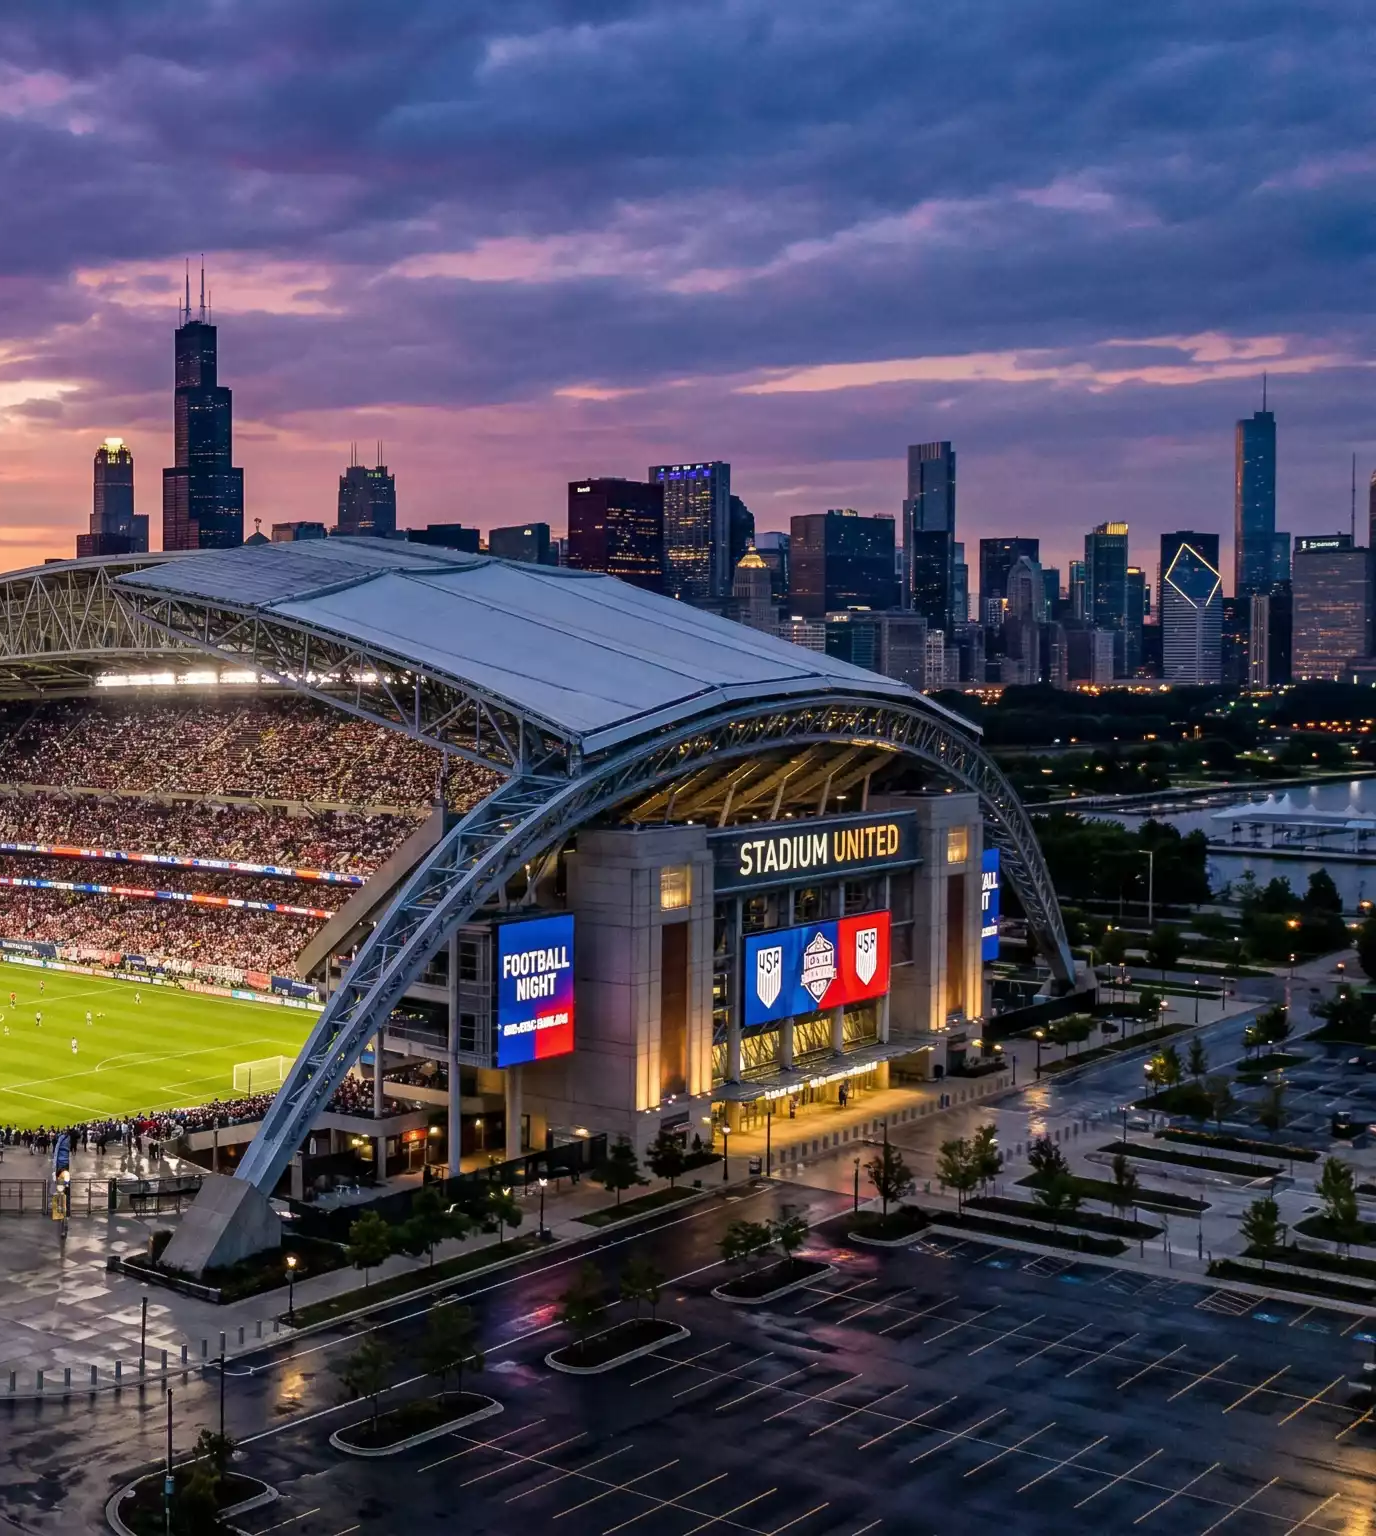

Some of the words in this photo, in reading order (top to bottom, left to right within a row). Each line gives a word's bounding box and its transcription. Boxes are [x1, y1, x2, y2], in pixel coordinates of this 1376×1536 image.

[739, 833, 828, 876] STADIUM
[834, 824, 899, 862] UNITED
[503, 946, 570, 979] FOOTBALL
[517, 973, 557, 1001] NIGHT
